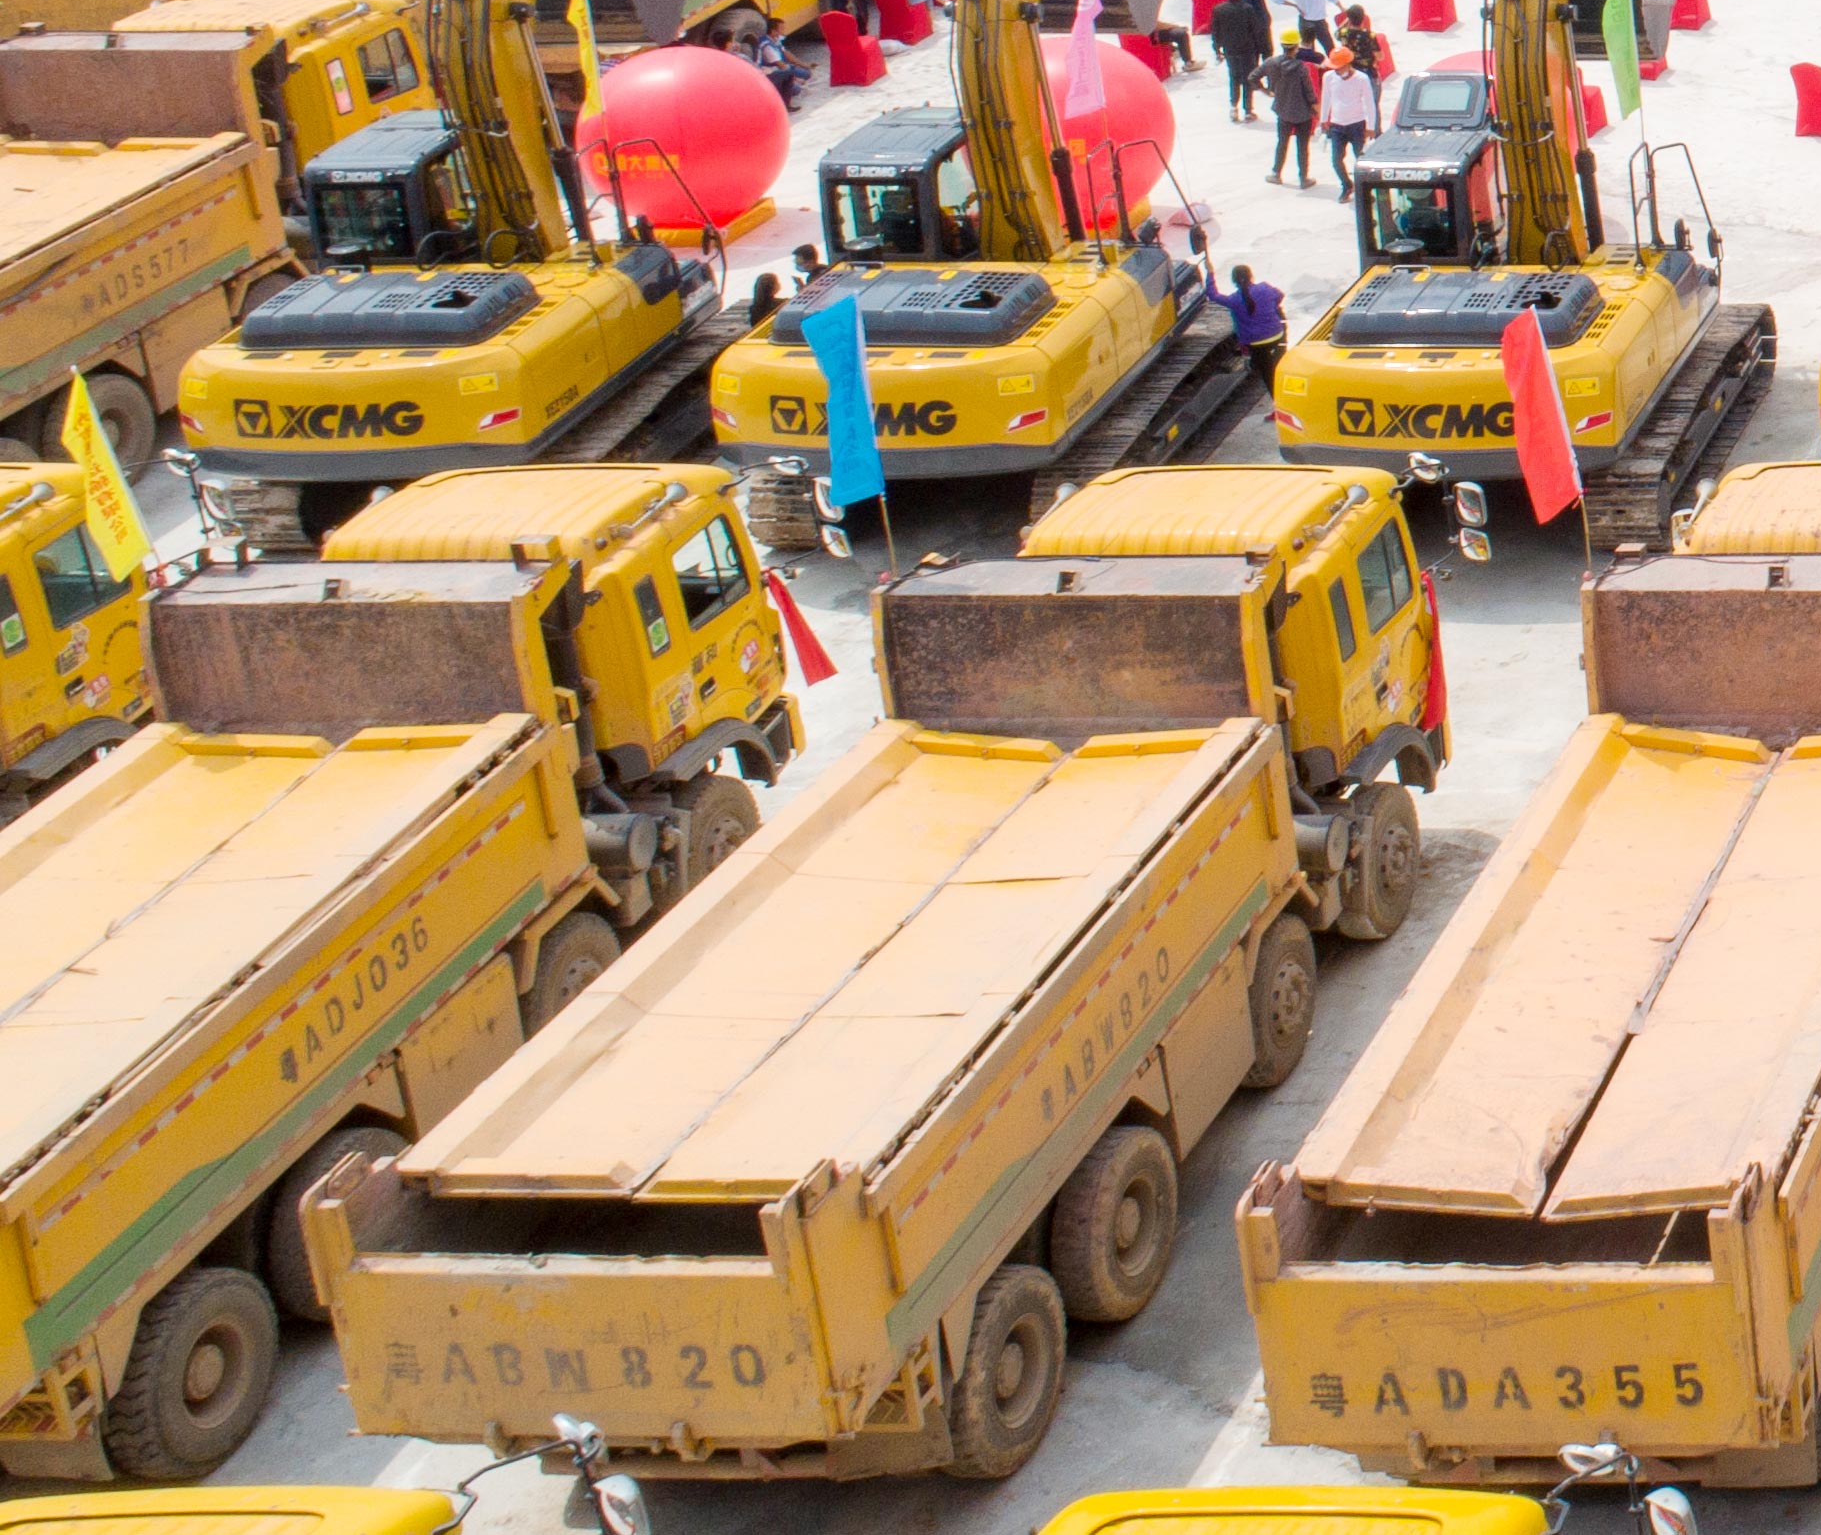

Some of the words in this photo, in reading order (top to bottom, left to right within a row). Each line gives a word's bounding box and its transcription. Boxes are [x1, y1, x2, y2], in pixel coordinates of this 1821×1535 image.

[344, 171, 383, 183] XCMG
[859, 166, 897, 177] XCMG
[1394, 170, 1431, 181] XCMG
[276, 400, 424, 440] XCMG
[1378, 401, 1516, 439] XCMG
[1311, 1361, 1705, 1417] 粤ADA355
